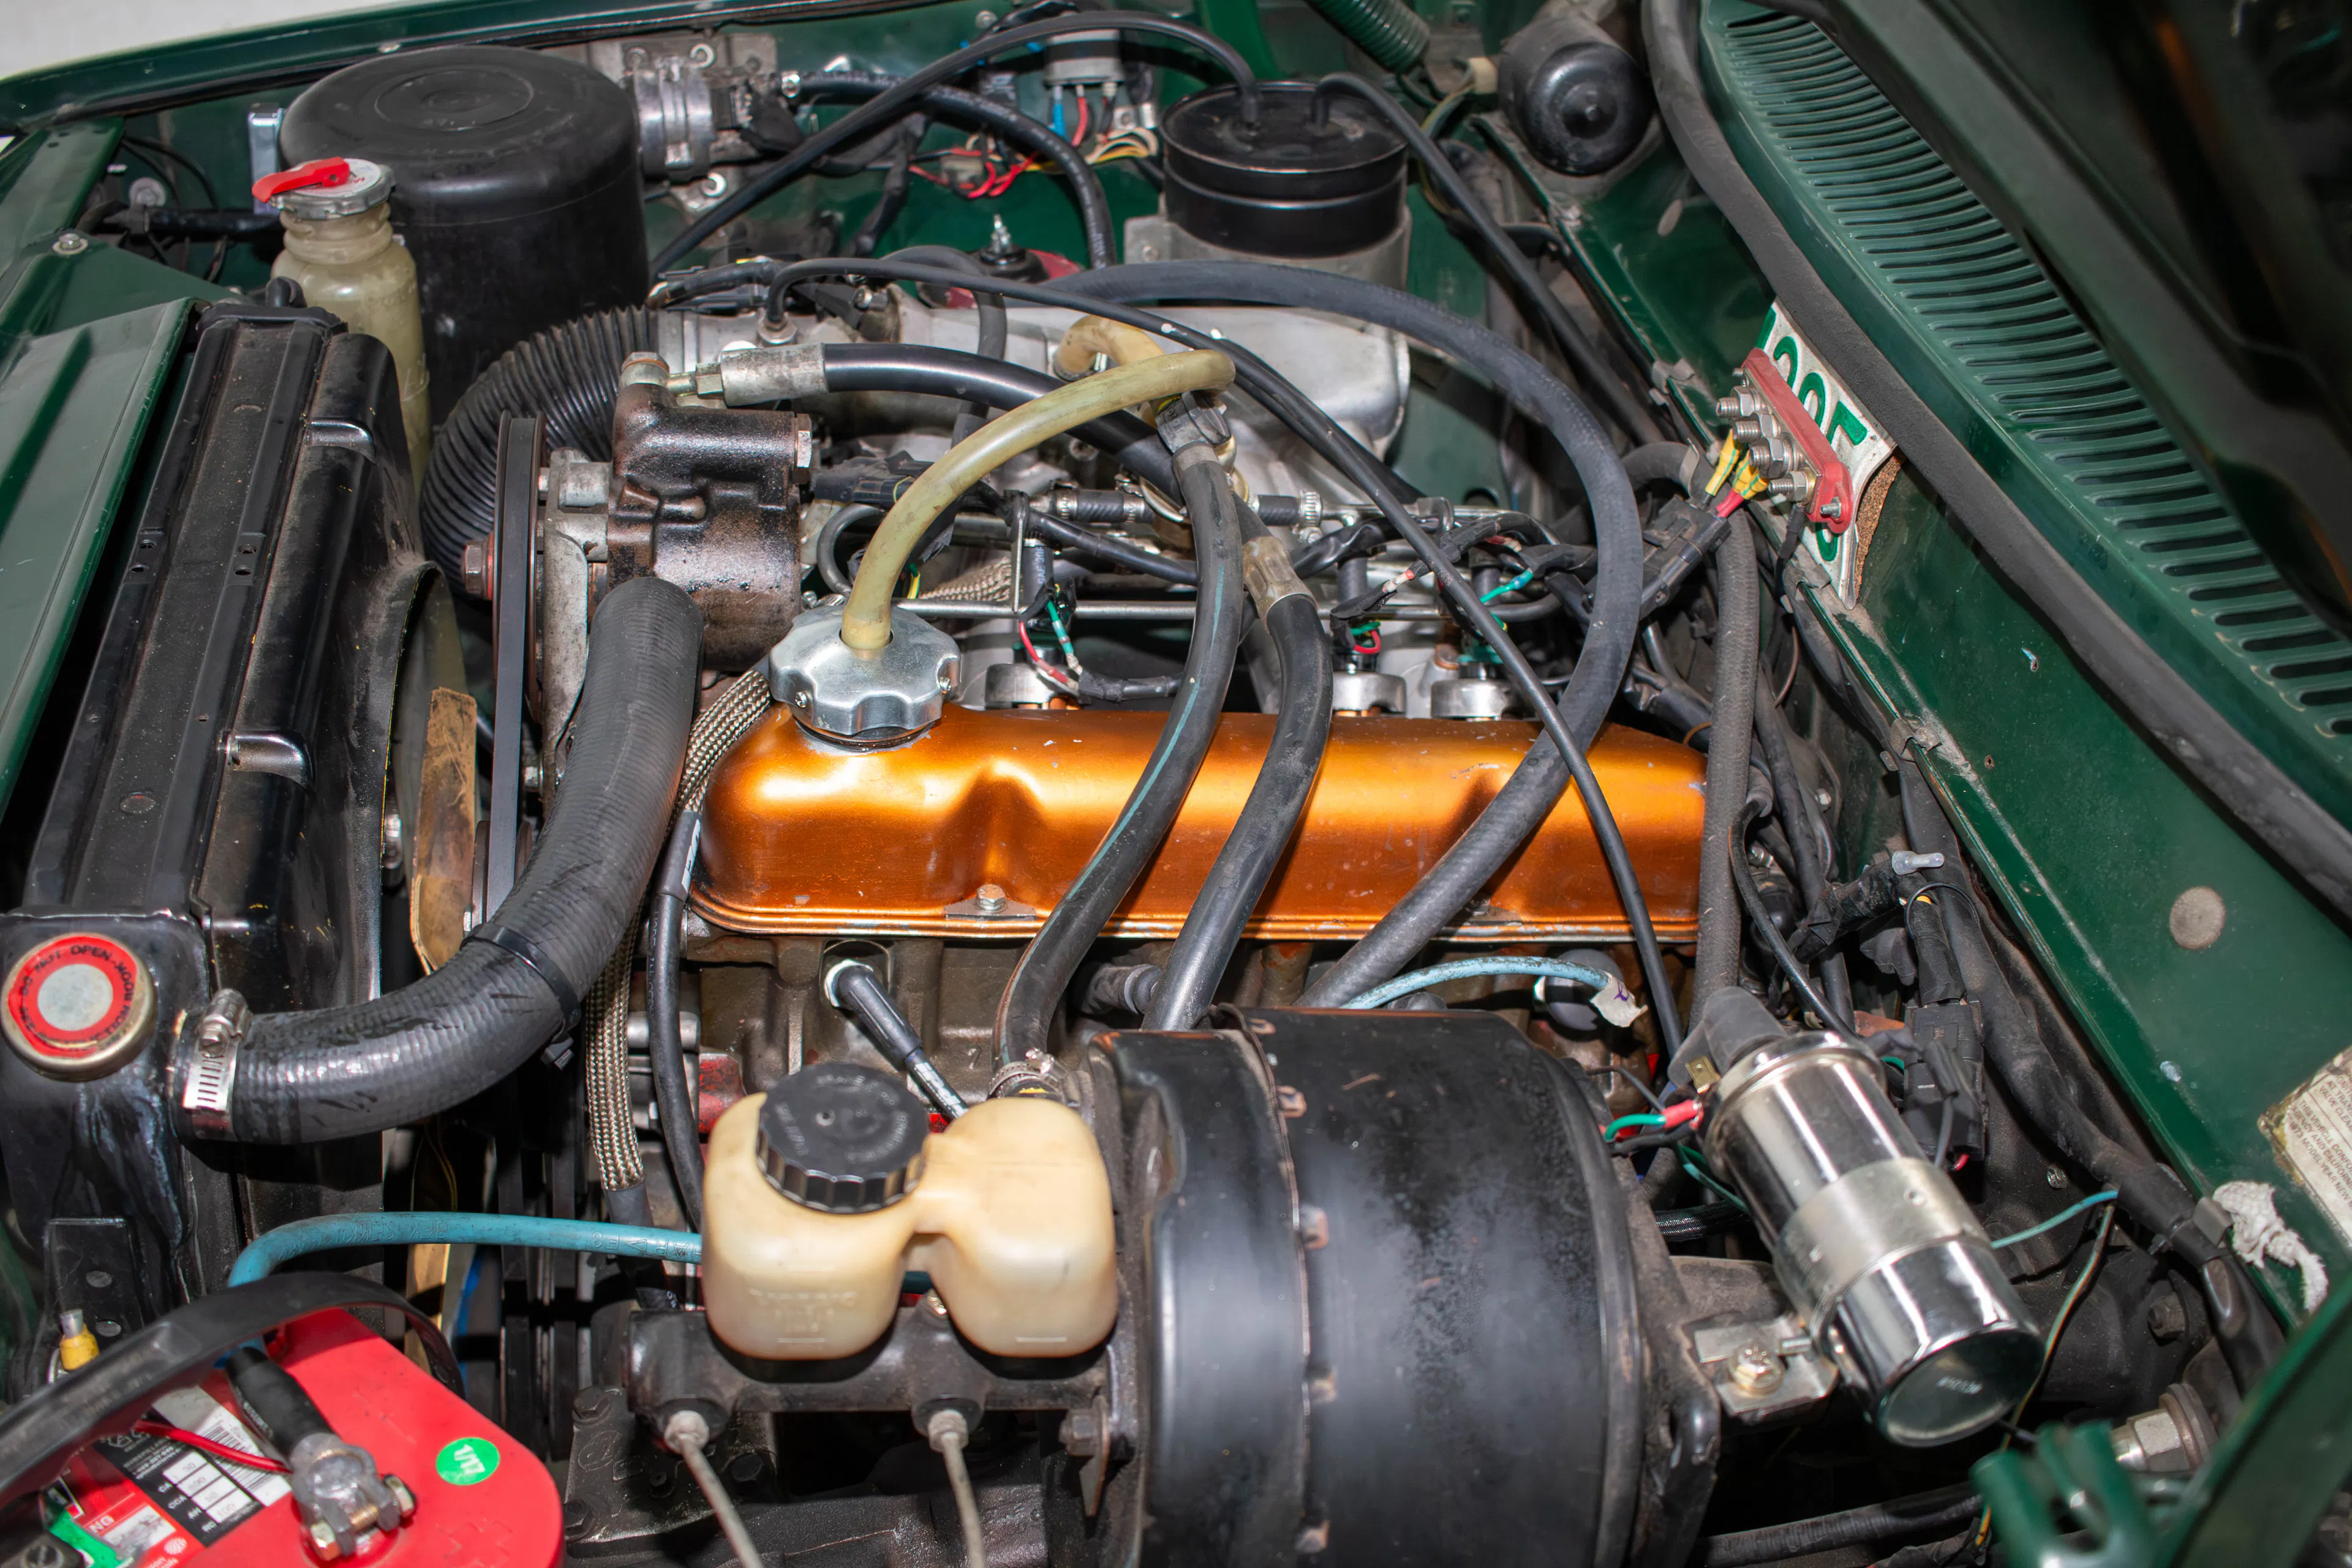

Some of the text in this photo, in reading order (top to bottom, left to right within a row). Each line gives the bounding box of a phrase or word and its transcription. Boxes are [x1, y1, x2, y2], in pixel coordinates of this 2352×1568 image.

[2320, 1085, 2338, 1108] VALVE
[2299, 1099, 2313, 1117] THIS
[2310, 1114, 2335, 1145] VEHICLE
[2311, 1133, 2326, 1150] AND
[2301, 1137, 2323, 1164] MODEL
[2320, 1162, 2337, 1183] YEAR
[454, 1444, 486, 1475] 1/17
[157, 1481, 173, 1494] CA
[167, 1494, 187, 1510] CCA
